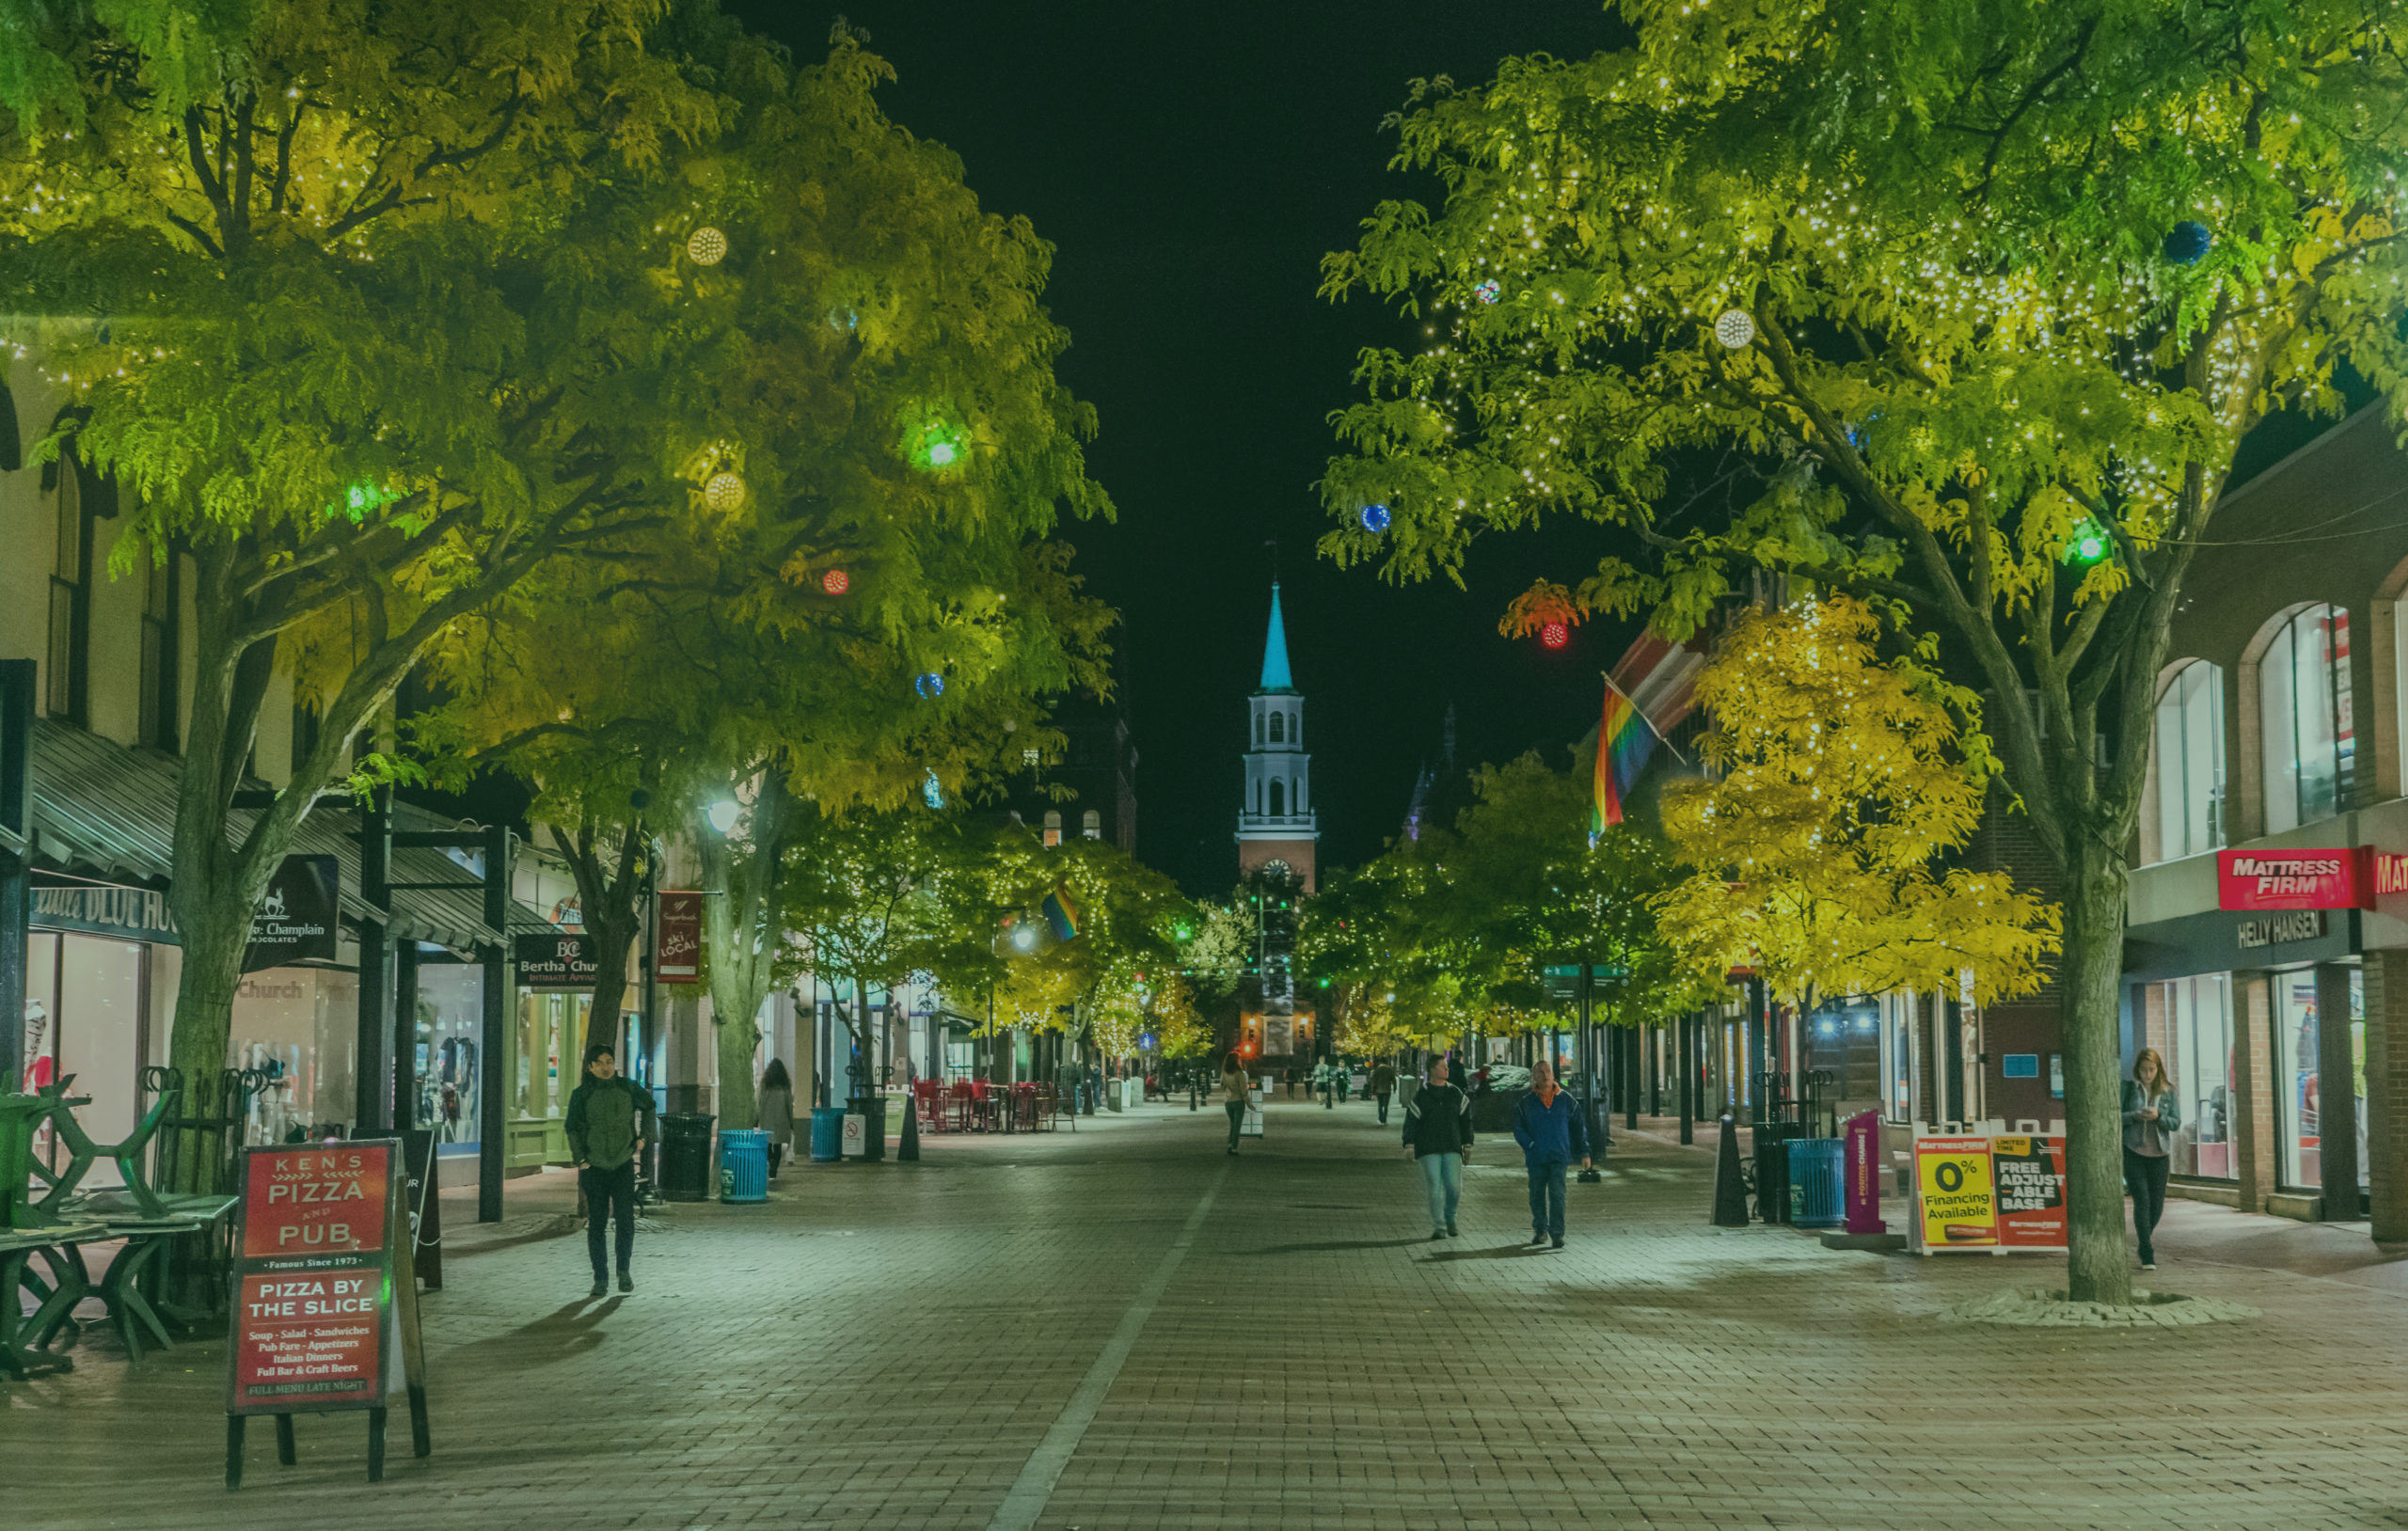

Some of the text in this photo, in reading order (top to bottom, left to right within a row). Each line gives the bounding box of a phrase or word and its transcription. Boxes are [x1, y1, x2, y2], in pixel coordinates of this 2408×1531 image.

[2232, 858, 2340, 876] MATTRESS
[2258, 876, 2318, 894] FIRM
[266, 923, 325, 937] Champlain
[2238, 910, 2321, 948] HELLY HANSEN
[660, 940, 698, 957] LOCAL
[520, 960, 565, 972] Bertha
[238, 980, 303, 999] Church
[276, 1155, 362, 1172] KEN'S
[1999, 1161, 2040, 1174] FREE
[2000, 1174, 2066, 1186] ADJUST
[268, 1180, 365, 1205] PIZZA
[1925, 1192, 1989, 1207] Financing
[2002, 1198, 2045, 1210] BASE
[302, 1207, 332, 1221] AND
[1927, 1206, 1988, 1220] Available
[278, 1223, 351, 1246] PUB
[269, 1257, 357, 1269] Famous Since 1973
[259, 1280, 364, 1299] PIZZA BY
[248, 1298, 373, 1318] THE SLICE
[248, 1332, 274, 1342] Soup
[280, 1328, 307, 1339] Salad
[314, 1326, 370, 1337] Sandwiches
[259, 1343, 277, 1352] Pub
[279, 1342, 300, 1350] Fare
[309, 1338, 359, 1351] Appetizers
[274, 1352, 343, 1364] Italian Dinners
[257, 1363, 358, 1377] Full Bar & Craft Beers
[249, 1381, 365, 1395] FULL MENU LATE NIGHT
